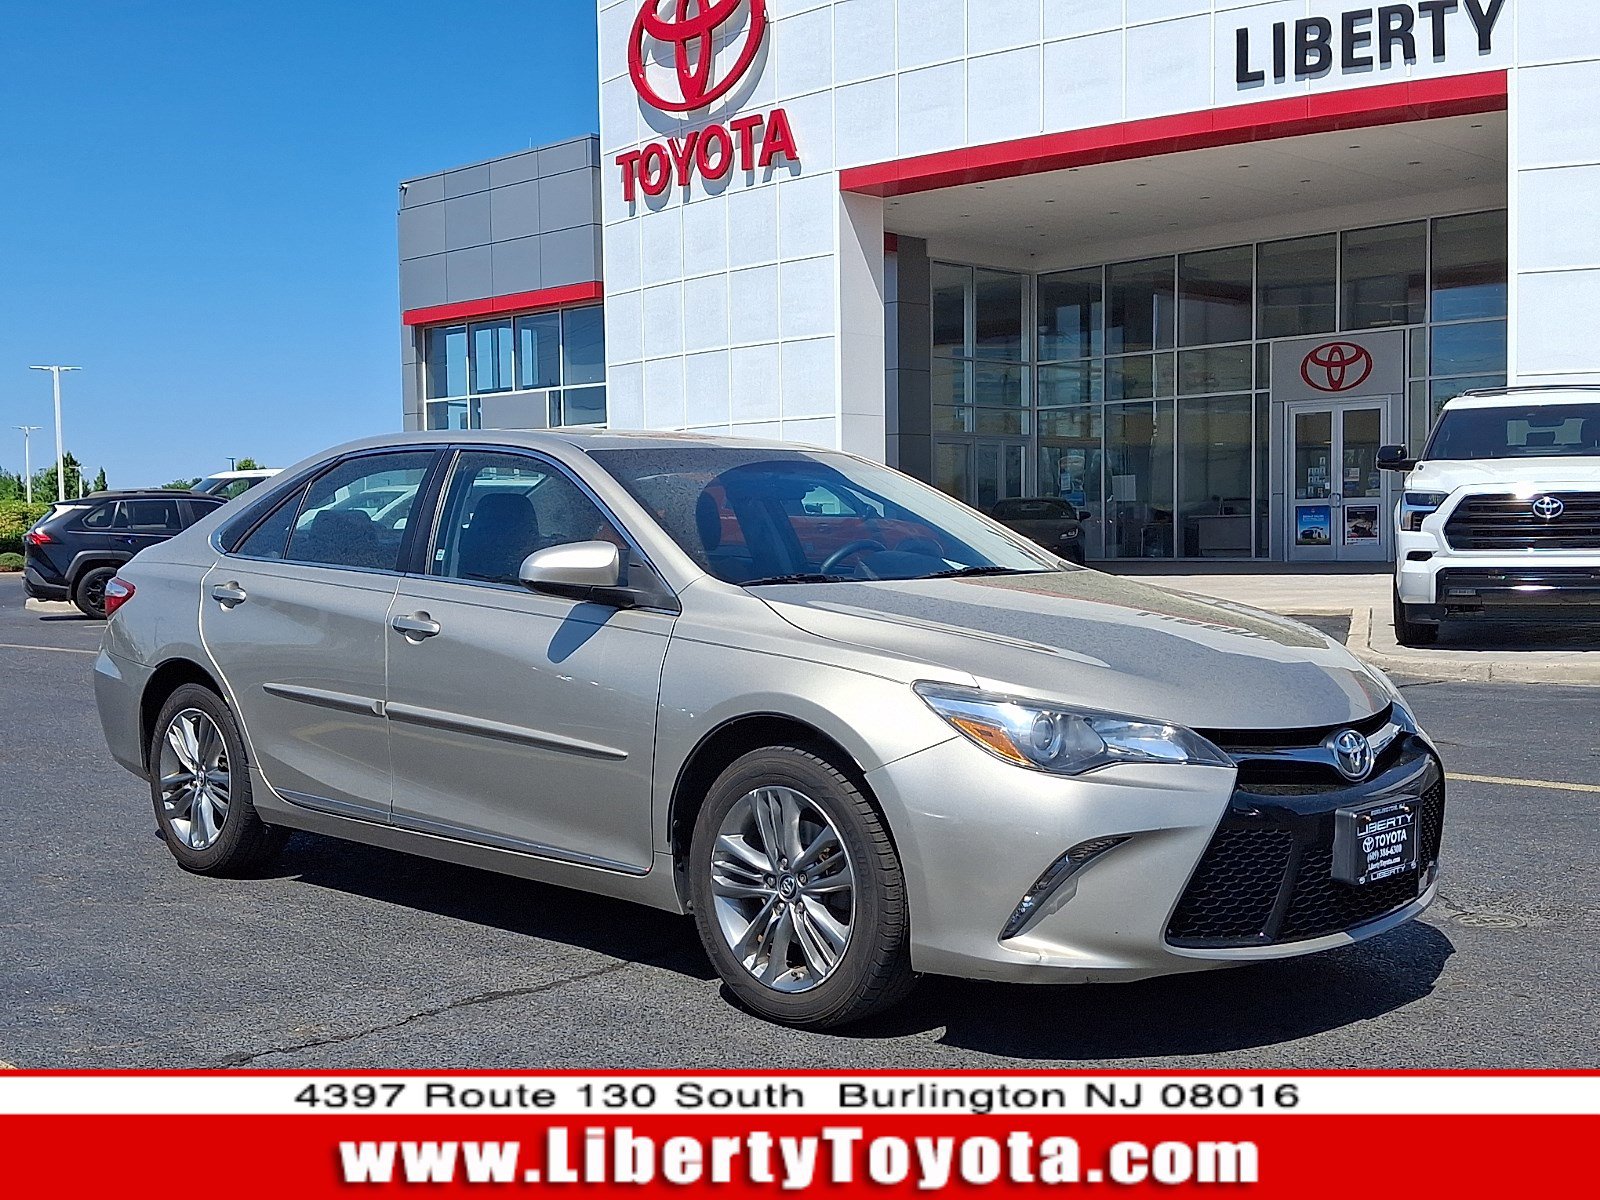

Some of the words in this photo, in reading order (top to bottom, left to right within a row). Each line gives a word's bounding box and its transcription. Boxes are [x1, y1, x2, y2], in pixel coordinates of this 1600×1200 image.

[1236, 0, 1504, 84] LIBERTY
[616, 108, 799, 202] TOYOTA
[1357, 812, 1414, 837] LIBERTY
[1375, 829, 1407, 848] TOYOTA
[1370, 864, 1405, 880] LIBERTY
